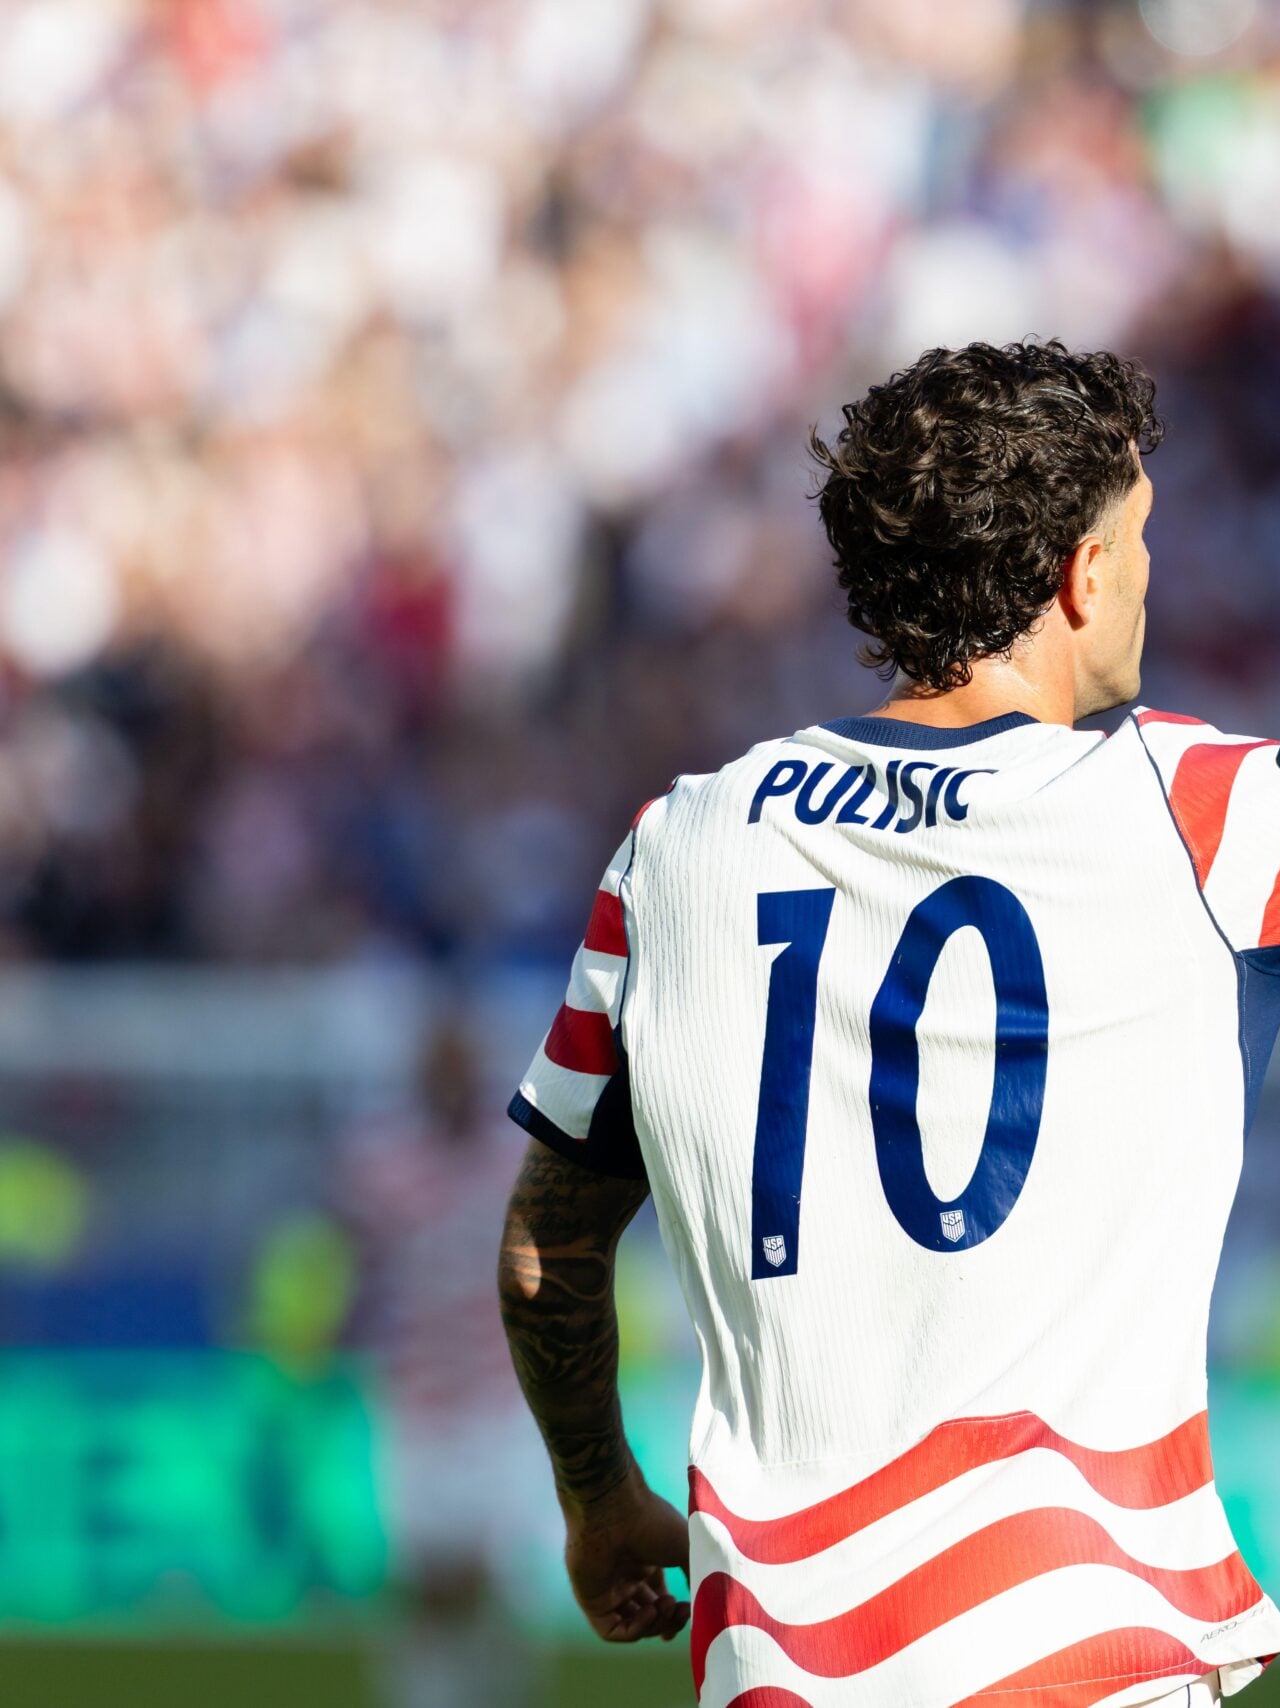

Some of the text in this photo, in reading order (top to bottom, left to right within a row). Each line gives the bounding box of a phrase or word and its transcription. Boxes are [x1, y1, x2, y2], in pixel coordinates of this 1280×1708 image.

[747, 759, 999, 834] PULISIC
[751, 874, 1049, 1280] 10
[942, 1212, 963, 1226] USA
[764, 1236, 784, 1251] USA
